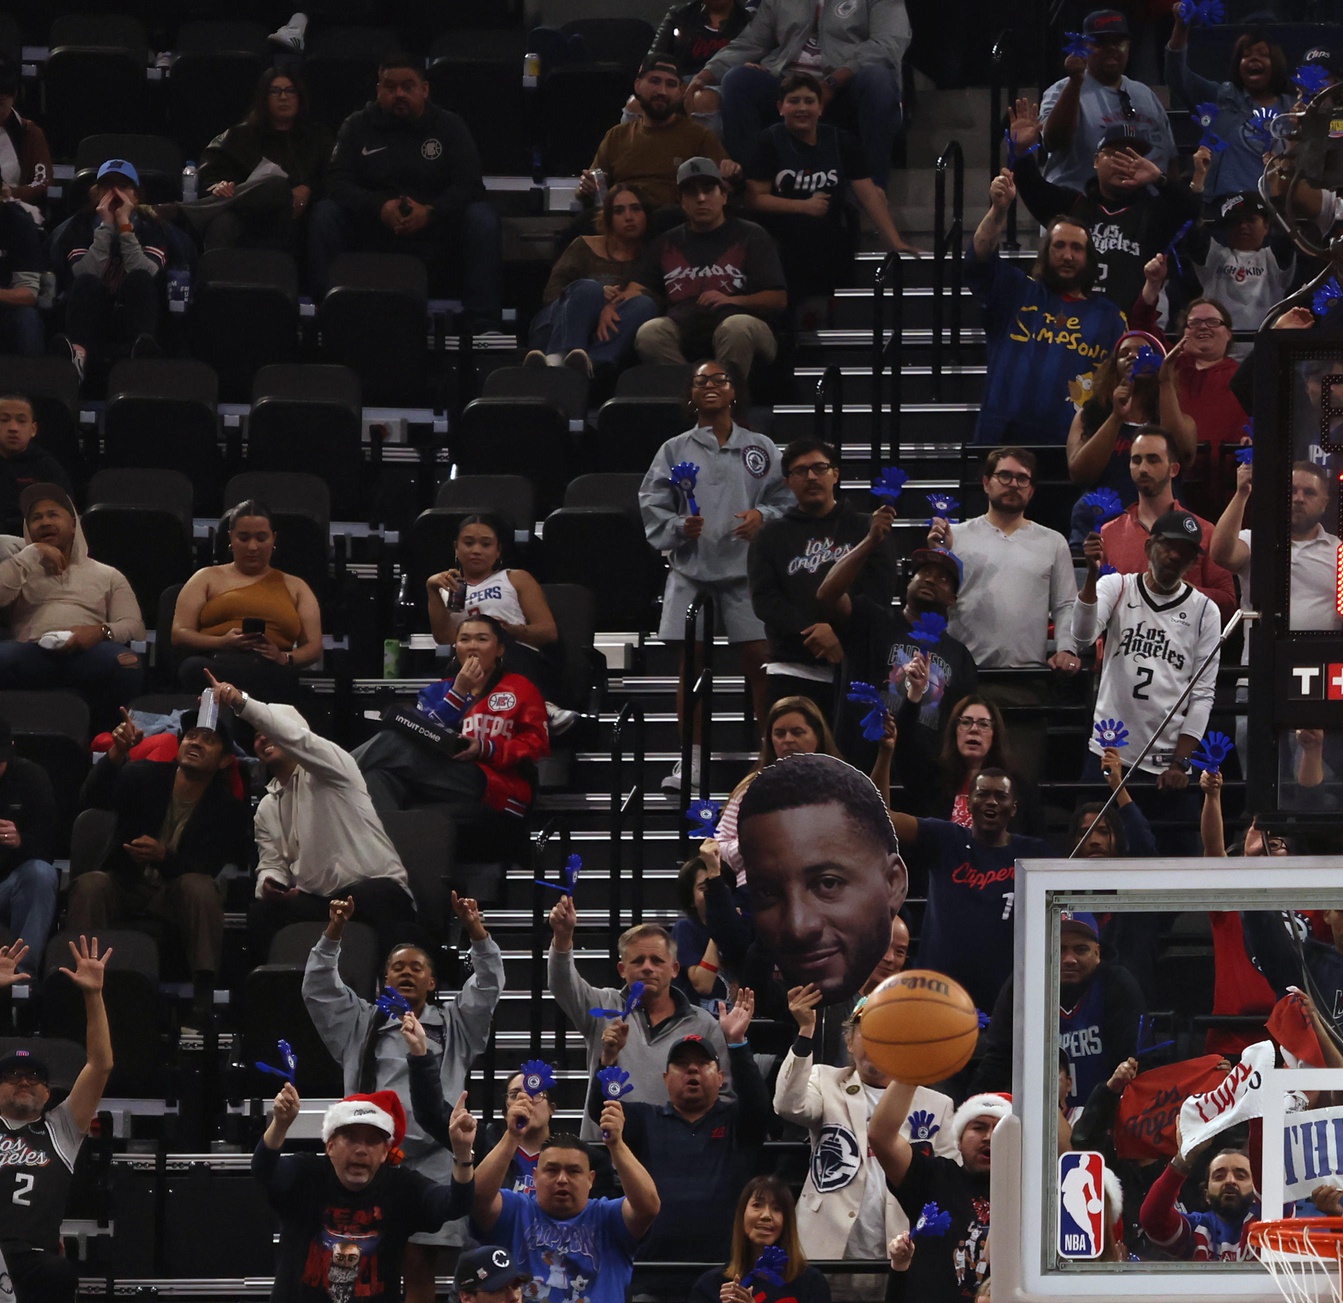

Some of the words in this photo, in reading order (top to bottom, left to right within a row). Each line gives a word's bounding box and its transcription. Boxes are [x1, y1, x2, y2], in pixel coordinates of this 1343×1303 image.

[775, 168, 838, 192] Clips
[1134, 622, 1167, 641] Los
[1113, 631, 1186, 669] Angeles
[1131, 667, 1154, 699] 2
[11, 1172, 35, 1207] 2
[1063, 1233, 1086, 1252] NBA
